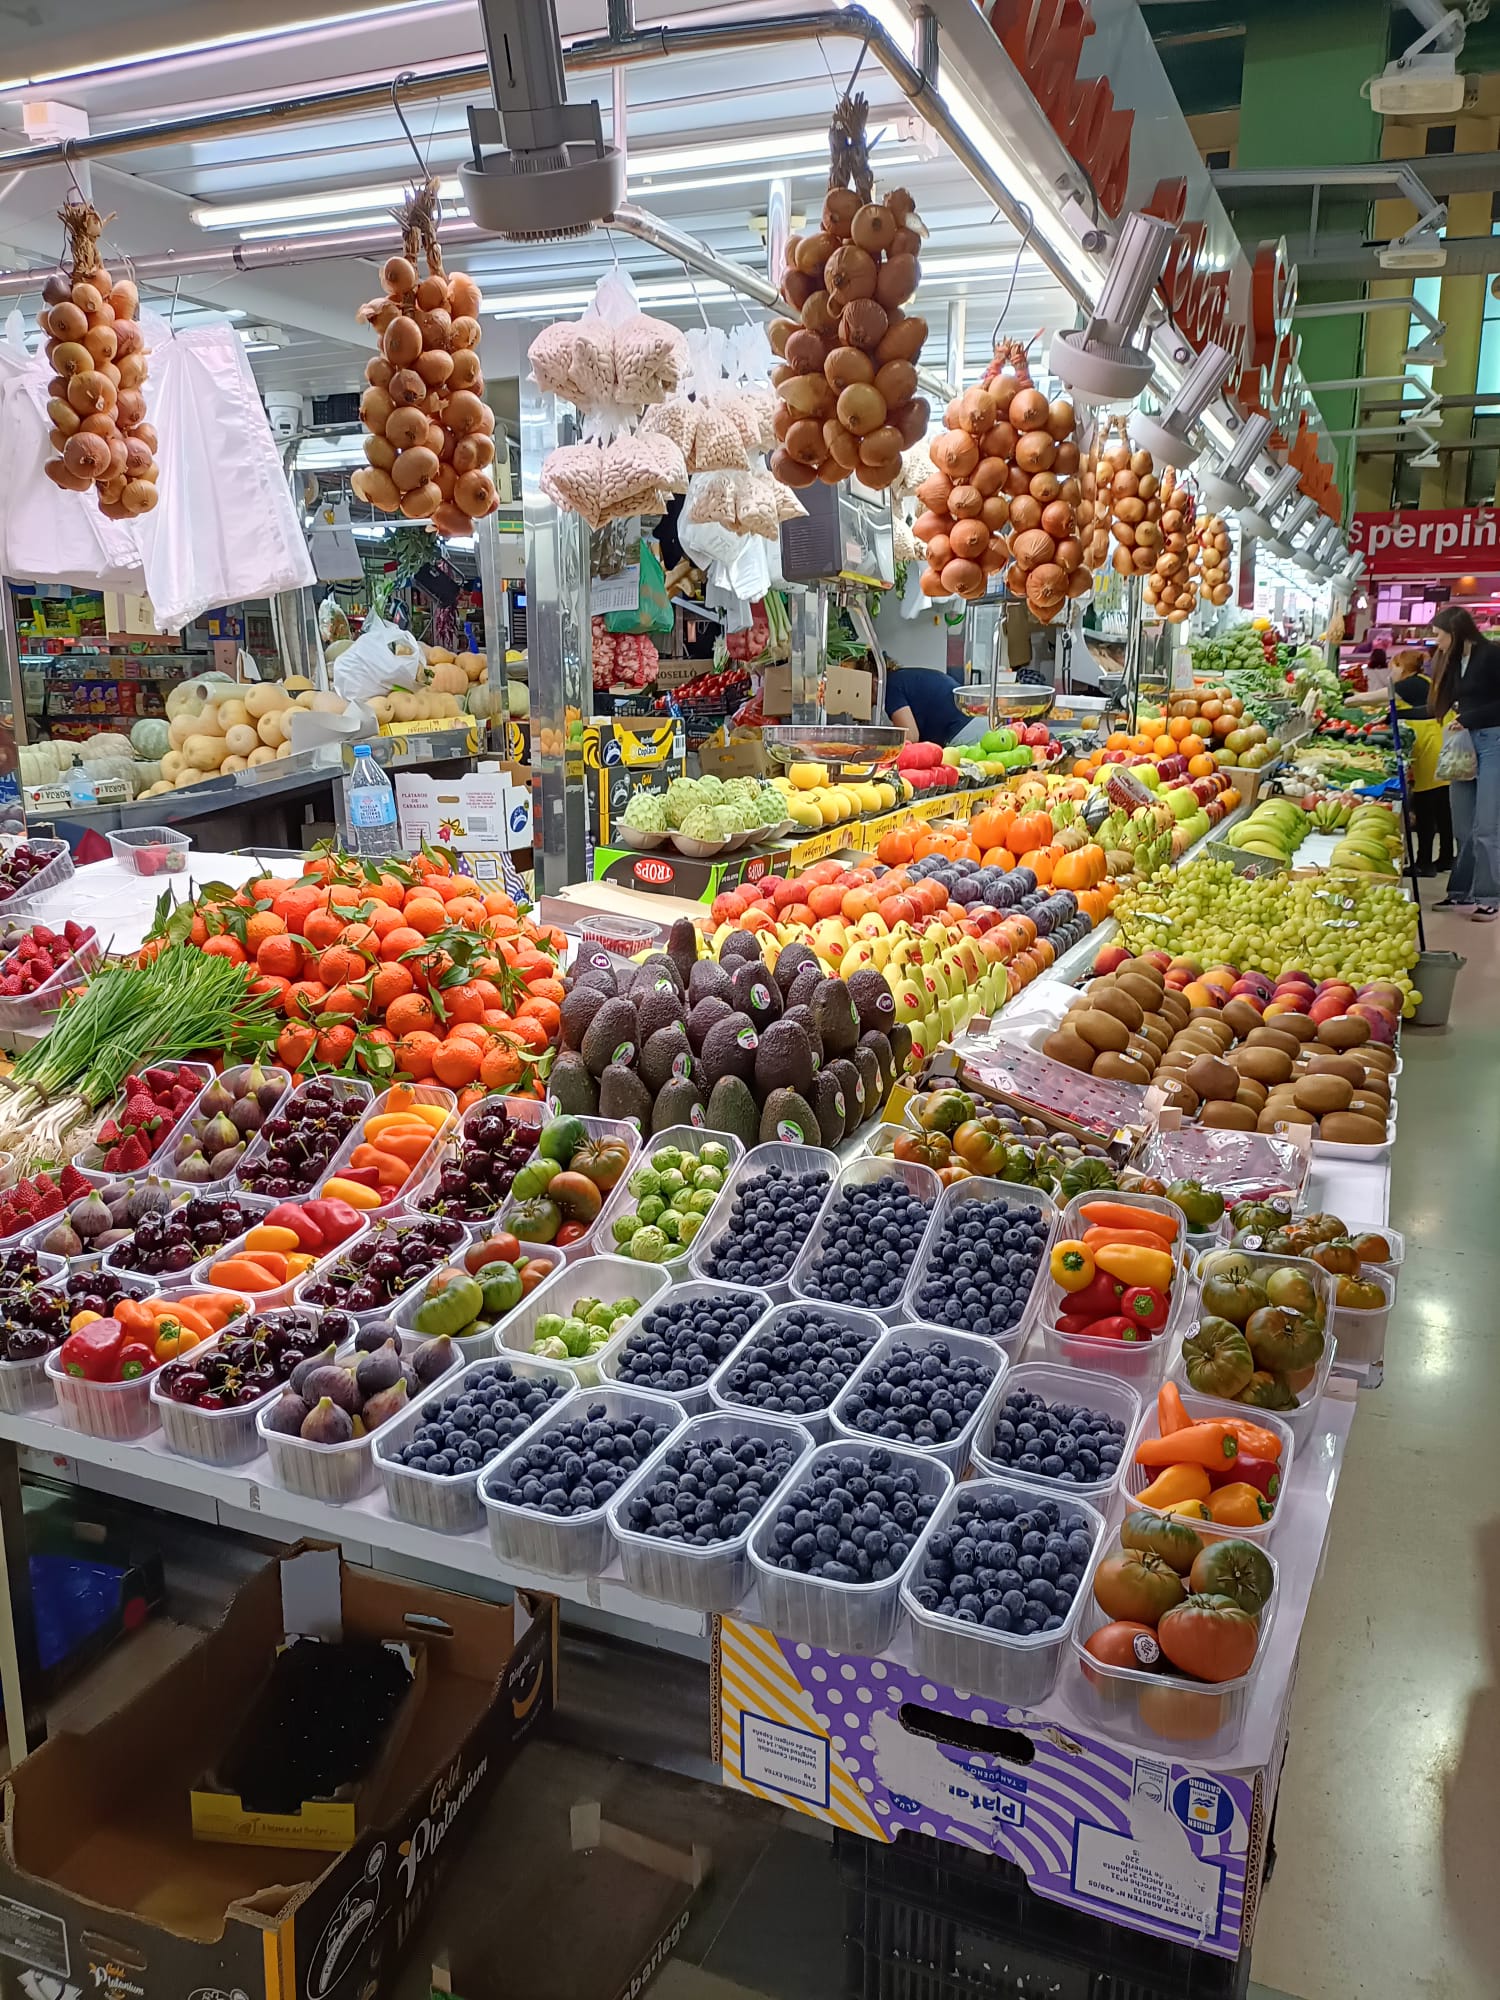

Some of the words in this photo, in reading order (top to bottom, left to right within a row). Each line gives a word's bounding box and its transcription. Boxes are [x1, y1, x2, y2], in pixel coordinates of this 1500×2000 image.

[1368, 513, 1500, 555] perpiñ
[44, 791, 71, 800] BORJA
[635, 863, 672, 880] TROPS
[748, 862, 765, 878] TROPS
[752, 1729, 773, 1740] España
[790, 1749, 816, 1762] Longitud
[764, 1767, 783, 1778] EXTRA
[803, 1773, 811, 1781] kg
[430, 1753, 462, 1815] Gold
[1189, 1778, 1222, 1794] CALIDAD
[892, 1796, 919, 1811] PLUS
[396, 1755, 488, 1897] Platanium
[1187, 1818, 1216, 1834] ORIGEN
[1125, 1855, 1140, 1864] 220
[1102, 1862, 1128, 1875] planta
[1120, 1860, 1153, 1875] Tenerife
[1130, 1879, 1163, 1894] Laroche
[1127, 1893, 1162, 1910] AGRITEN
[1166, 1890, 1180, 1901] Fco.
[1163, 1905, 1179, 1915] SAT
[94, 1966, 144, 1995] Platanium
